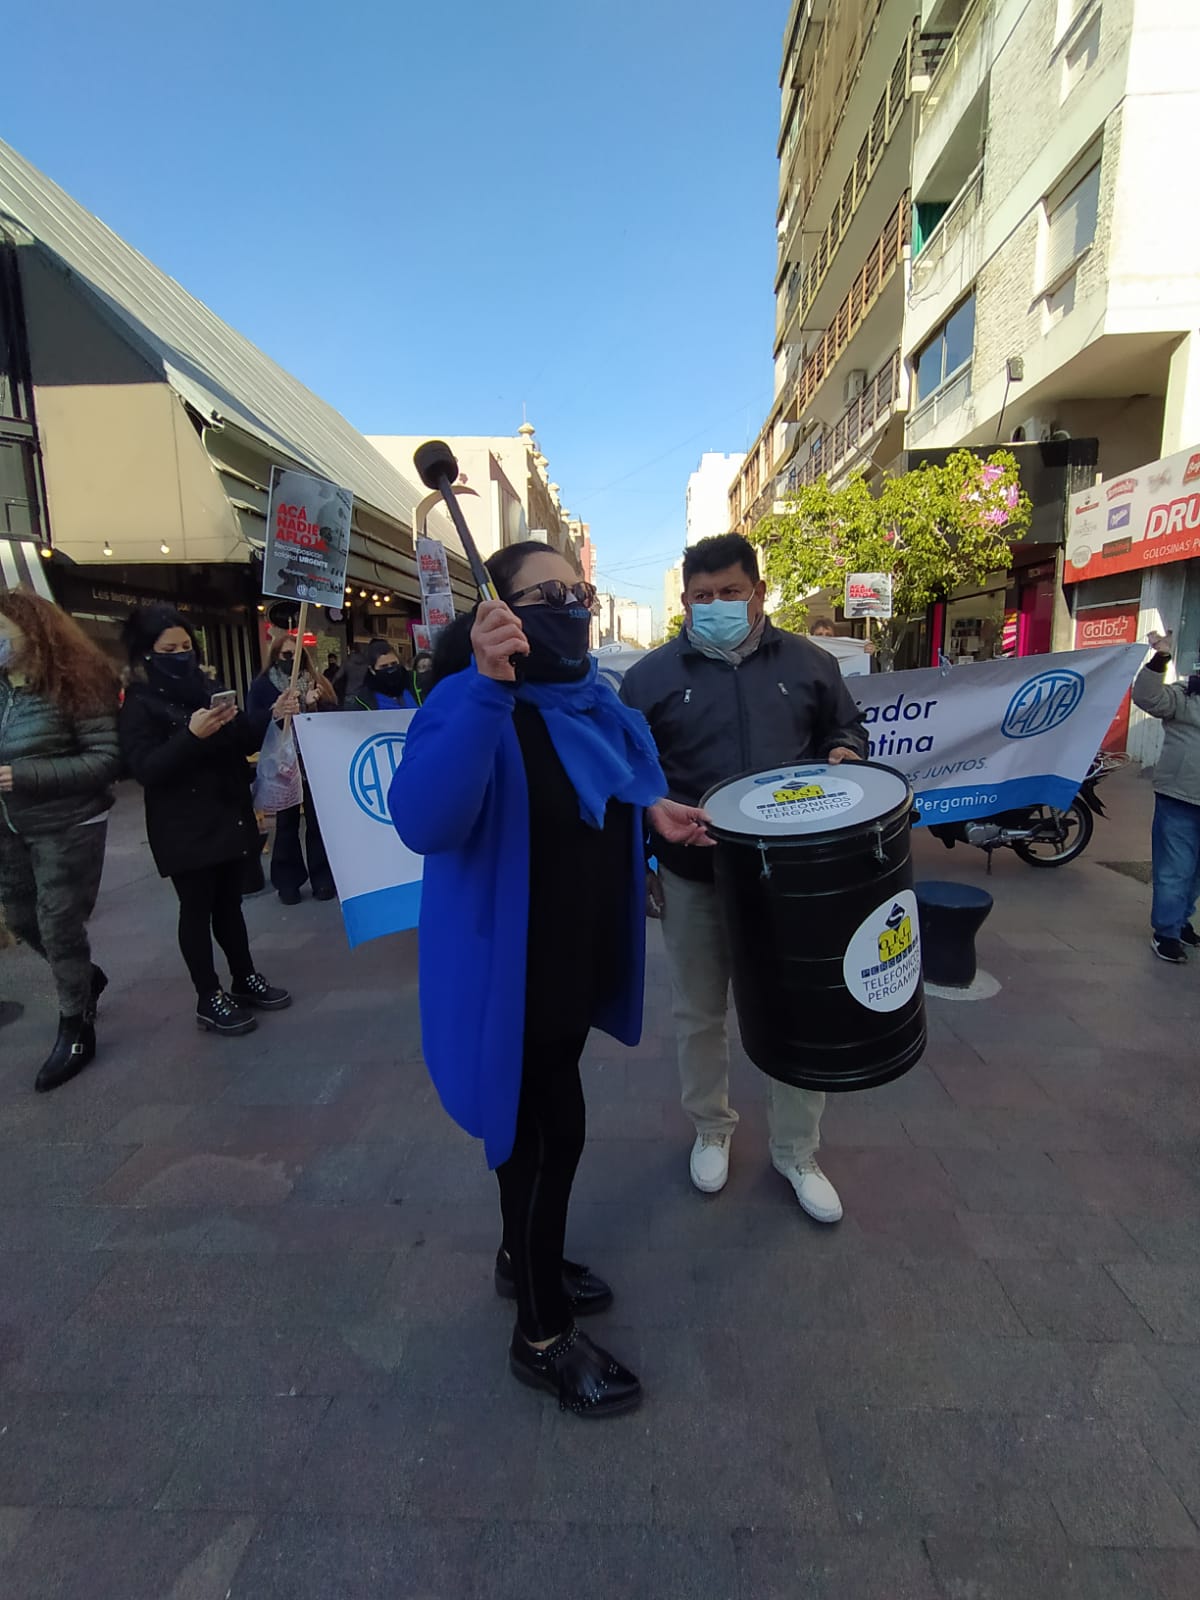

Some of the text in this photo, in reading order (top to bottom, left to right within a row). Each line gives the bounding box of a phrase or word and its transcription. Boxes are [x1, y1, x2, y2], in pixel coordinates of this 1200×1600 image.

[276, 515, 320, 537] NADIE
[1143, 540, 1191, 560] GOLOSINAS
[299, 555, 328, 568] URGENTE
[856, 693, 937, 724] ador
[922, 757, 988, 779] JUNTOS.
[765, 801, 852, 820] PERGAMINO
[915, 791, 998, 813] Pergamino
